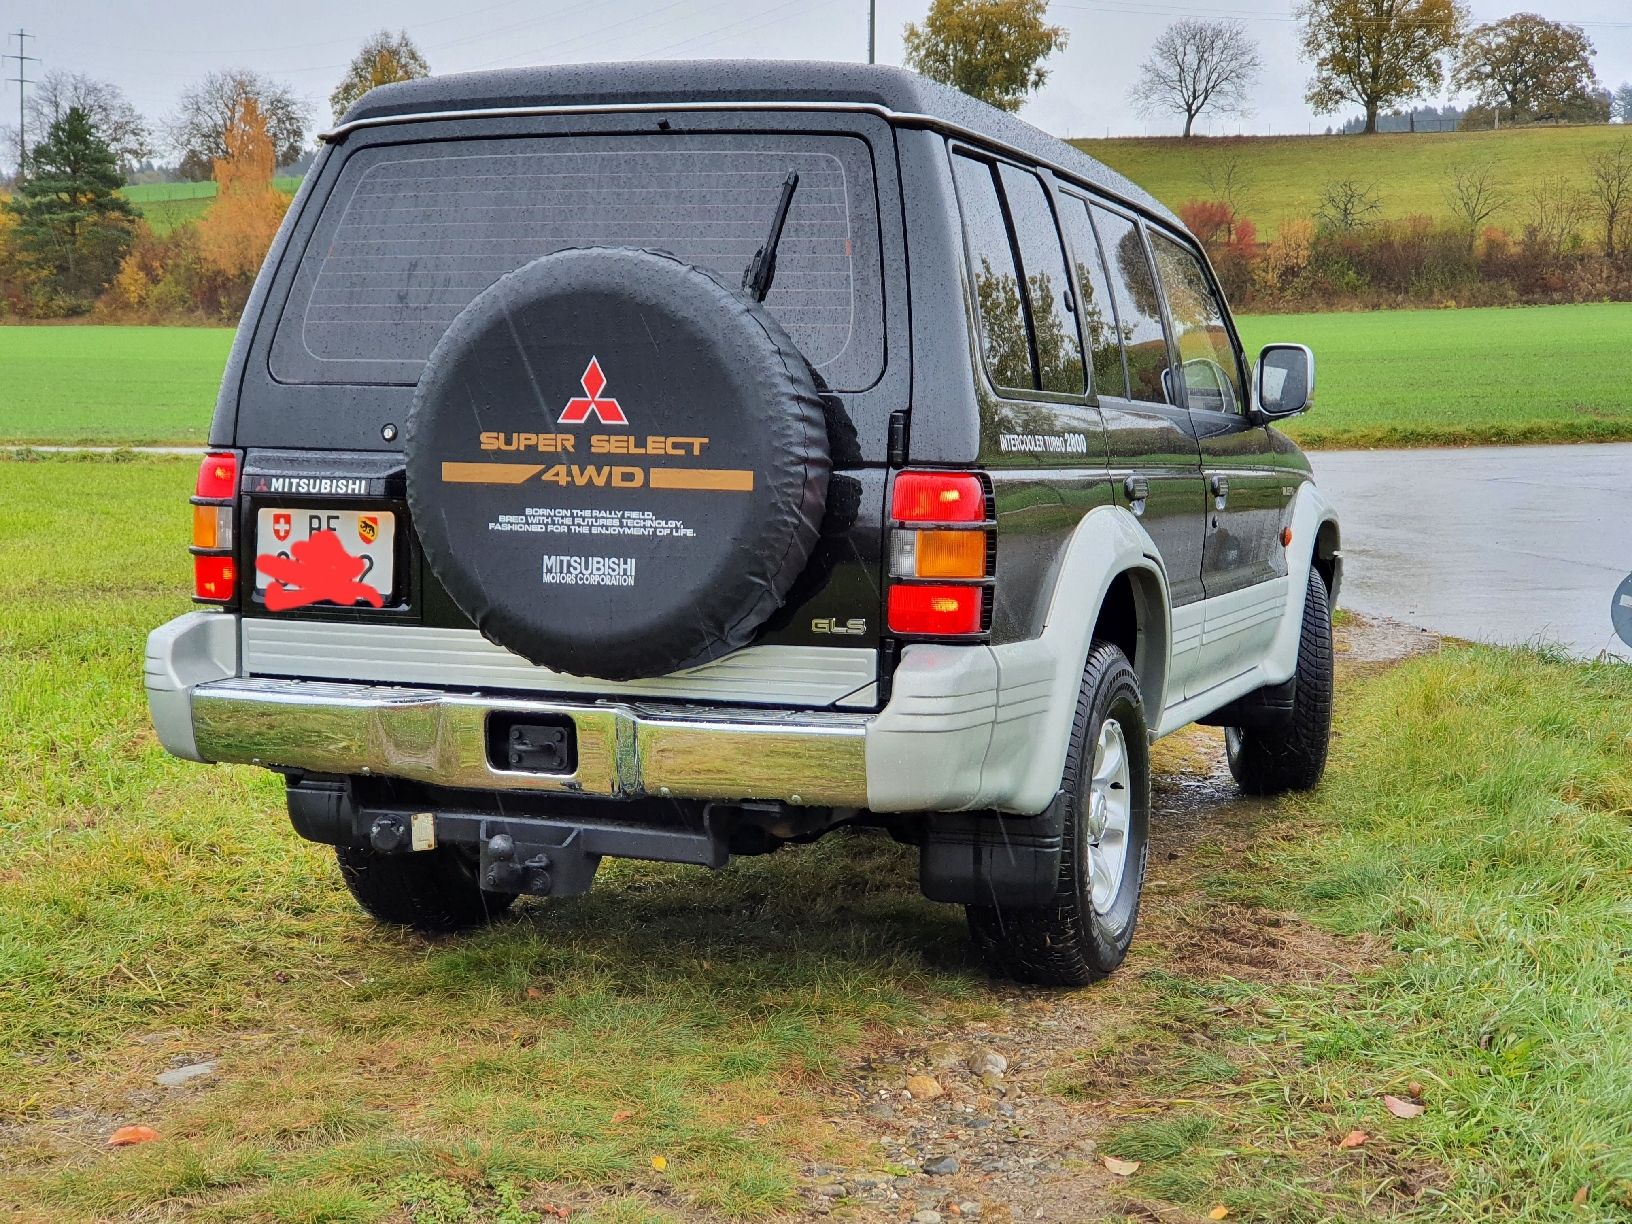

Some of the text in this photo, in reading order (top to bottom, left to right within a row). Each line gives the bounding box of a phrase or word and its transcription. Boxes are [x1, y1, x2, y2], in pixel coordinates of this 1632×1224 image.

[479, 431, 709, 456] SUPER SELECT
[999, 433, 1045, 453] INTERCOOLER
[1044, 435, 1065, 453] TURBO
[541, 464, 645, 488] 4WD
[270, 477, 366, 495] MITSUBISHI
[498, 515, 526, 523] BRED
[527, 516, 552, 524] WITH
[553, 517, 573, 525] THE
[574, 517, 620, 526] FUTURES
[525, 507, 656, 520] BORN ON THE RALLY FIELD,
[488, 523, 697, 537] FASHIONED FOR THE ENJOYMENT OF LIFE.
[543, 554, 636, 576] MITSUBISHI
[542, 573, 635, 586] MOTORS CORPORATION
[811, 617, 867, 635] GLS
